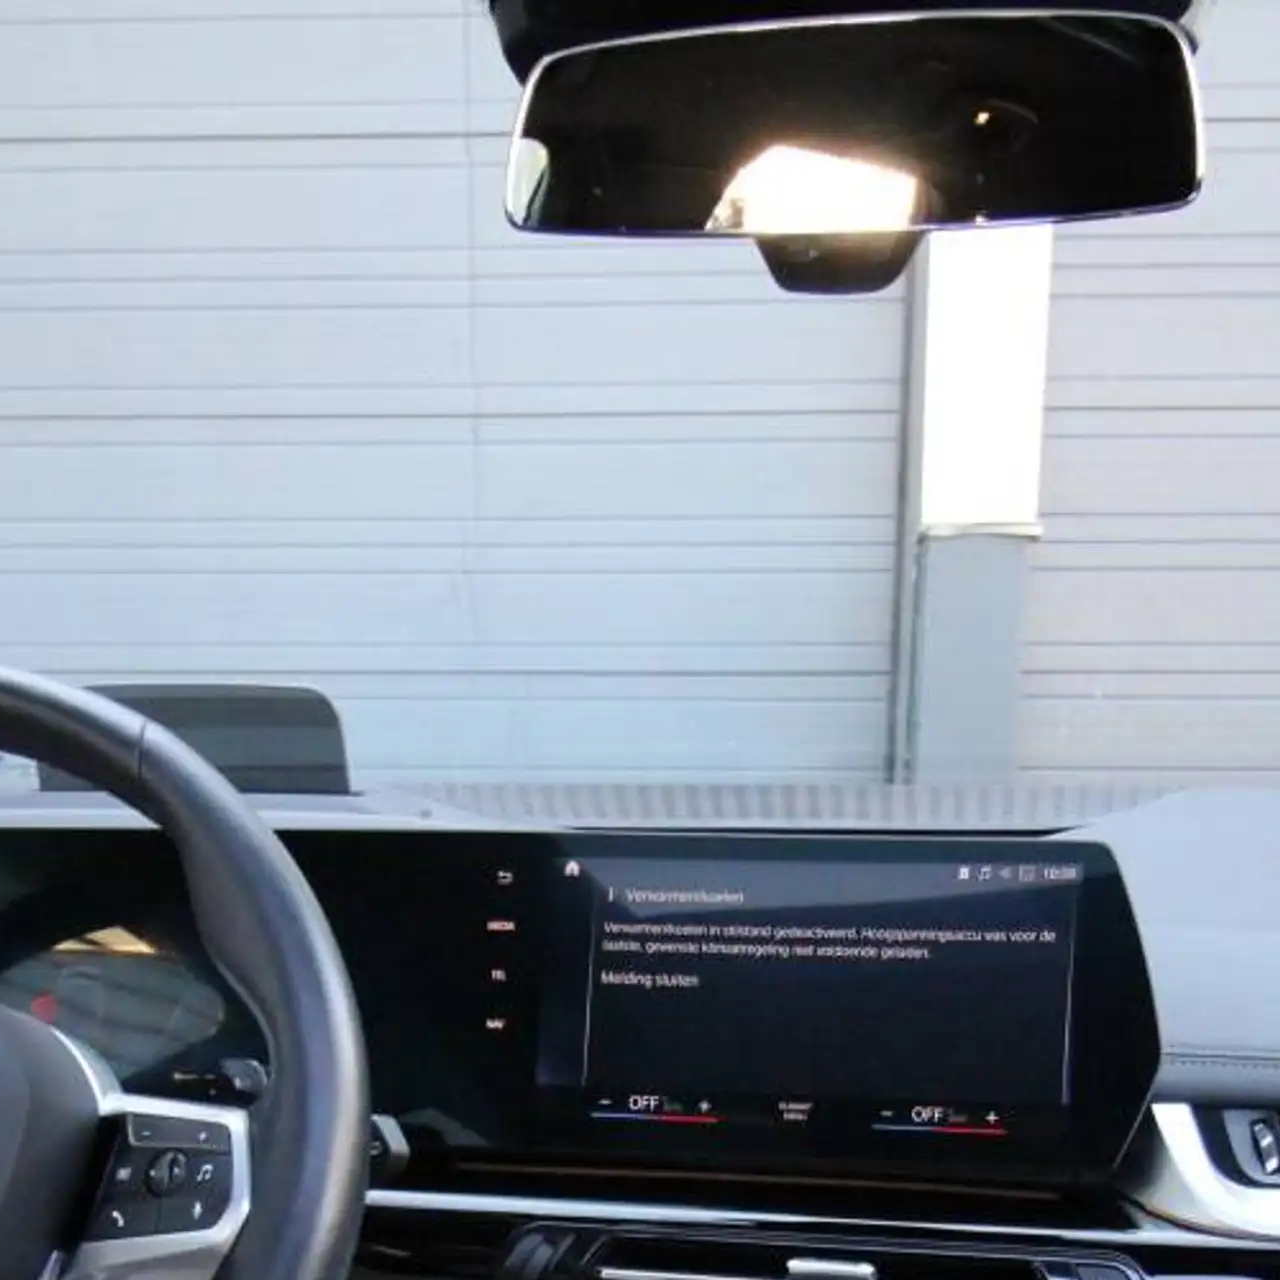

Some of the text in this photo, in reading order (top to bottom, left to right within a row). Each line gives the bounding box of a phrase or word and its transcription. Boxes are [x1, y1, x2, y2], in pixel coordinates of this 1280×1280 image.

[1009, 932, 1038, 943] voor
[1040, 930, 1056, 943] de
[600, 968, 653, 990] Melding
[628, 1094, 660, 1111] OFF
[911, 1105, 944, 1124] OFF
